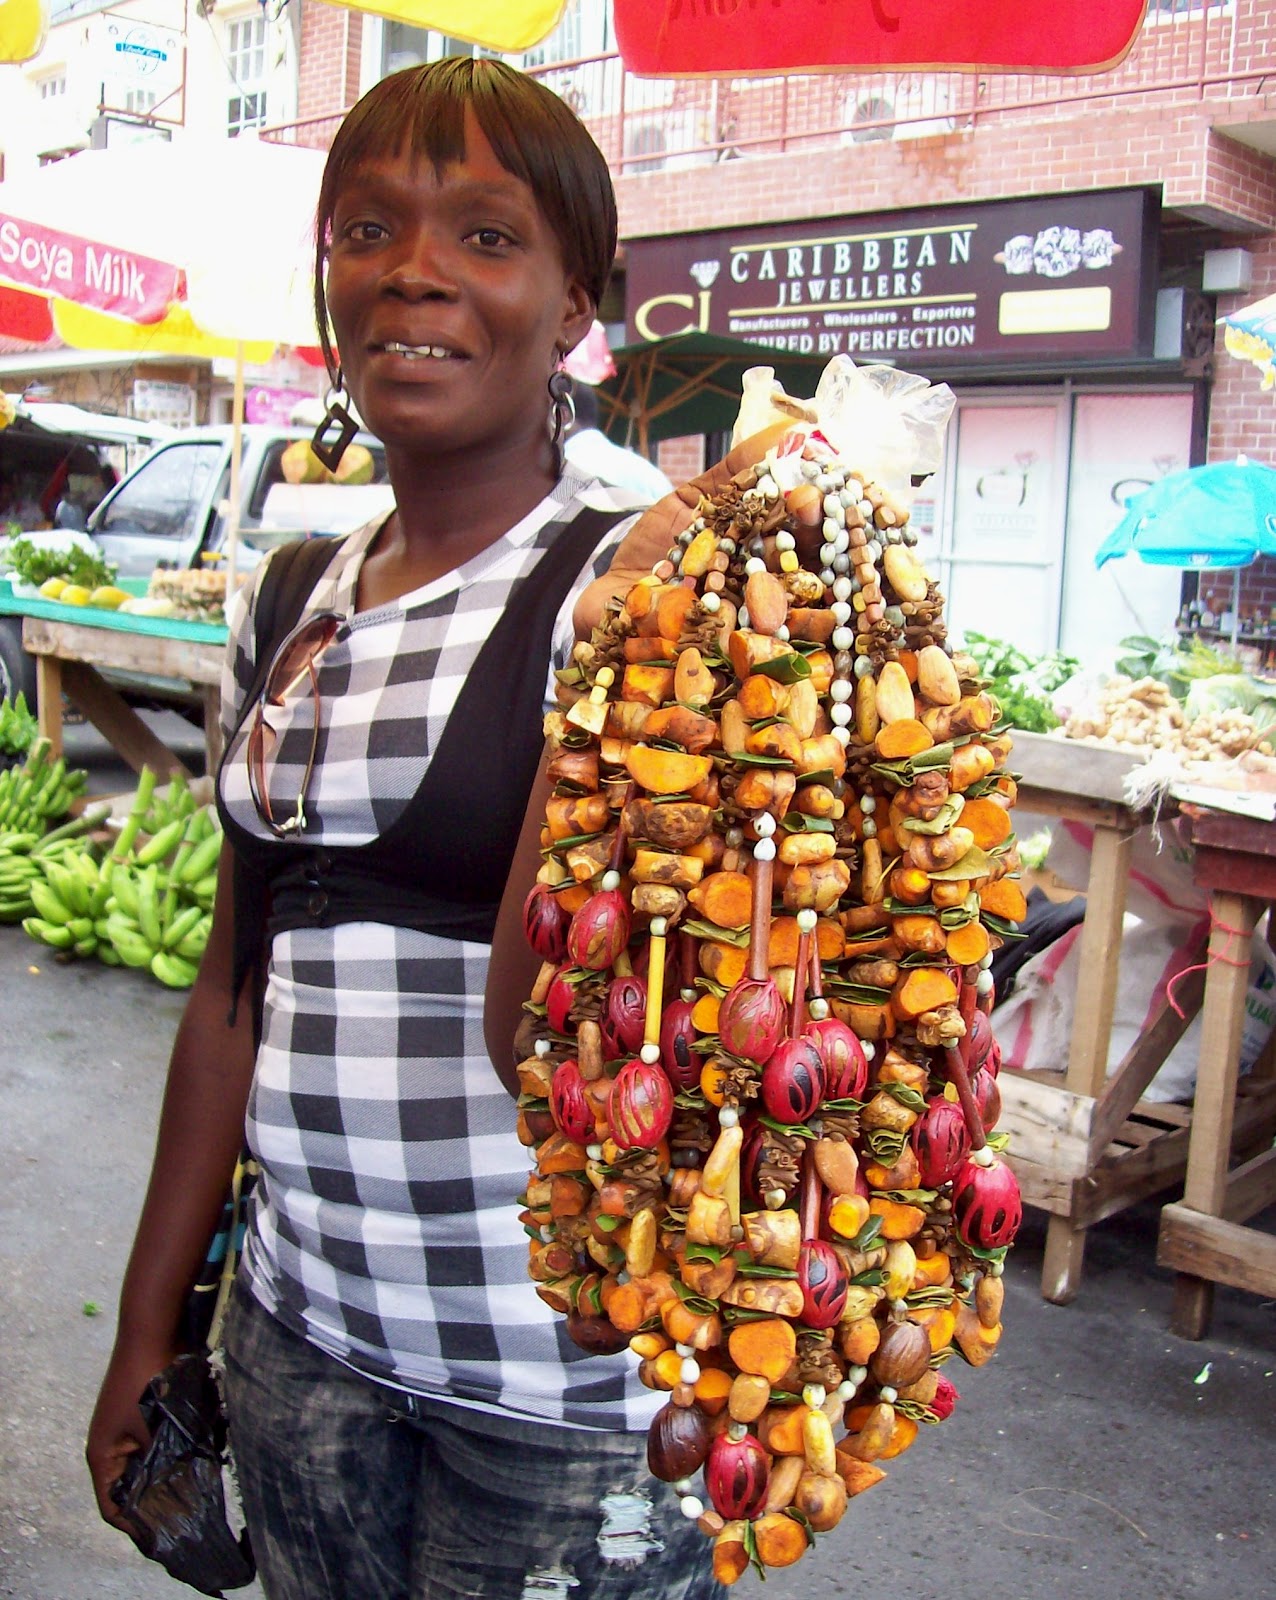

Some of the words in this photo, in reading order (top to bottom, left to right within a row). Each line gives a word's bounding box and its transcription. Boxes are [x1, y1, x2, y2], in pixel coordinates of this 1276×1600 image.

[0, 221, 73, 283] Soya
[85, 246, 145, 303] Milk
[730, 231, 972, 283] CARIBBEAN
[777, 271, 922, 308] JEWELLERS
[729, 317, 809, 333] Manufacturers
[823, 311, 898, 327] Wholesalers
[912, 306, 976, 323] Exporters
[818, 332, 842, 354] BY
[848, 324, 976, 352] PERFECTION
